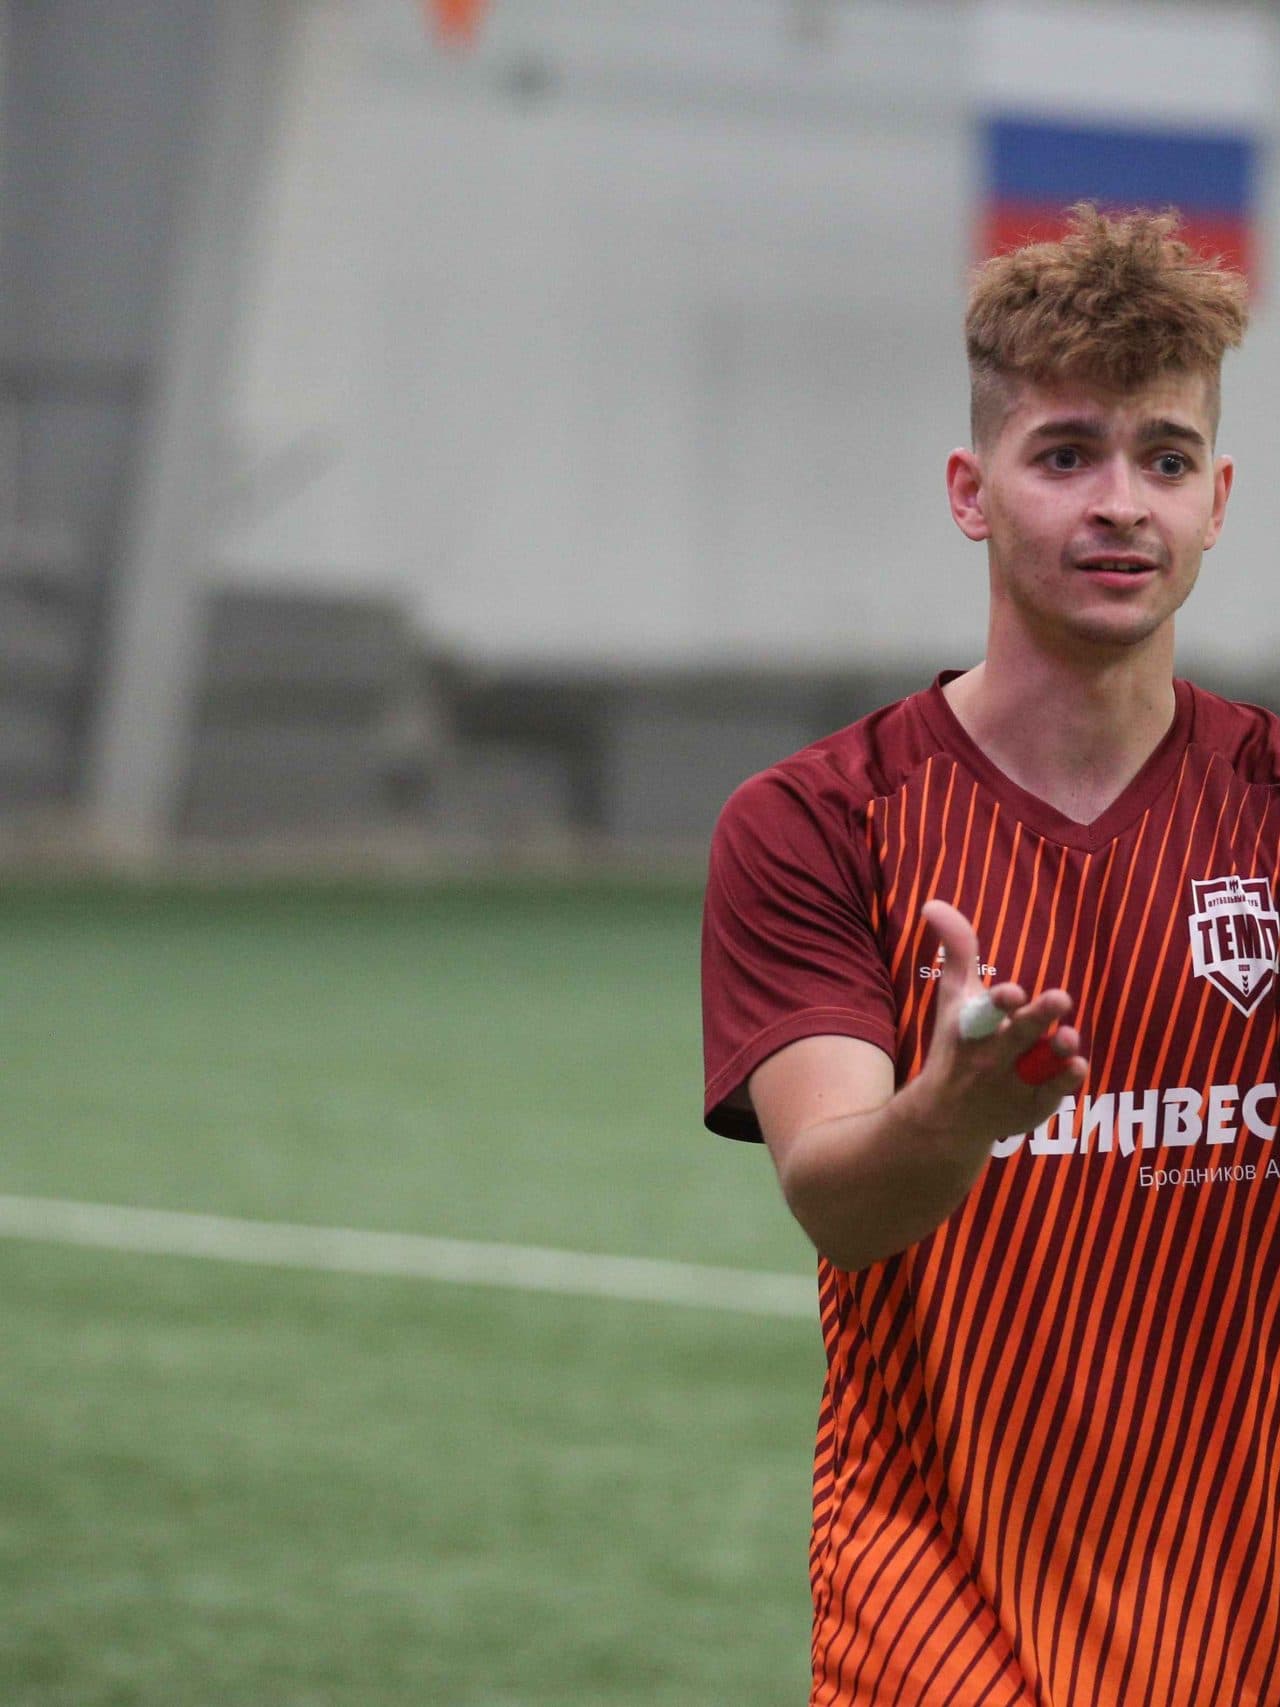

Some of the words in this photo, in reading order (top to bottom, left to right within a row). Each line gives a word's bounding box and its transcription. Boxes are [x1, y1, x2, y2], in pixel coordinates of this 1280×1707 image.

[1197, 914, 1280, 965] ТЕМП
[919, 964, 998, 980] Spife
[1139, 1161, 1257, 1191] Бродников
